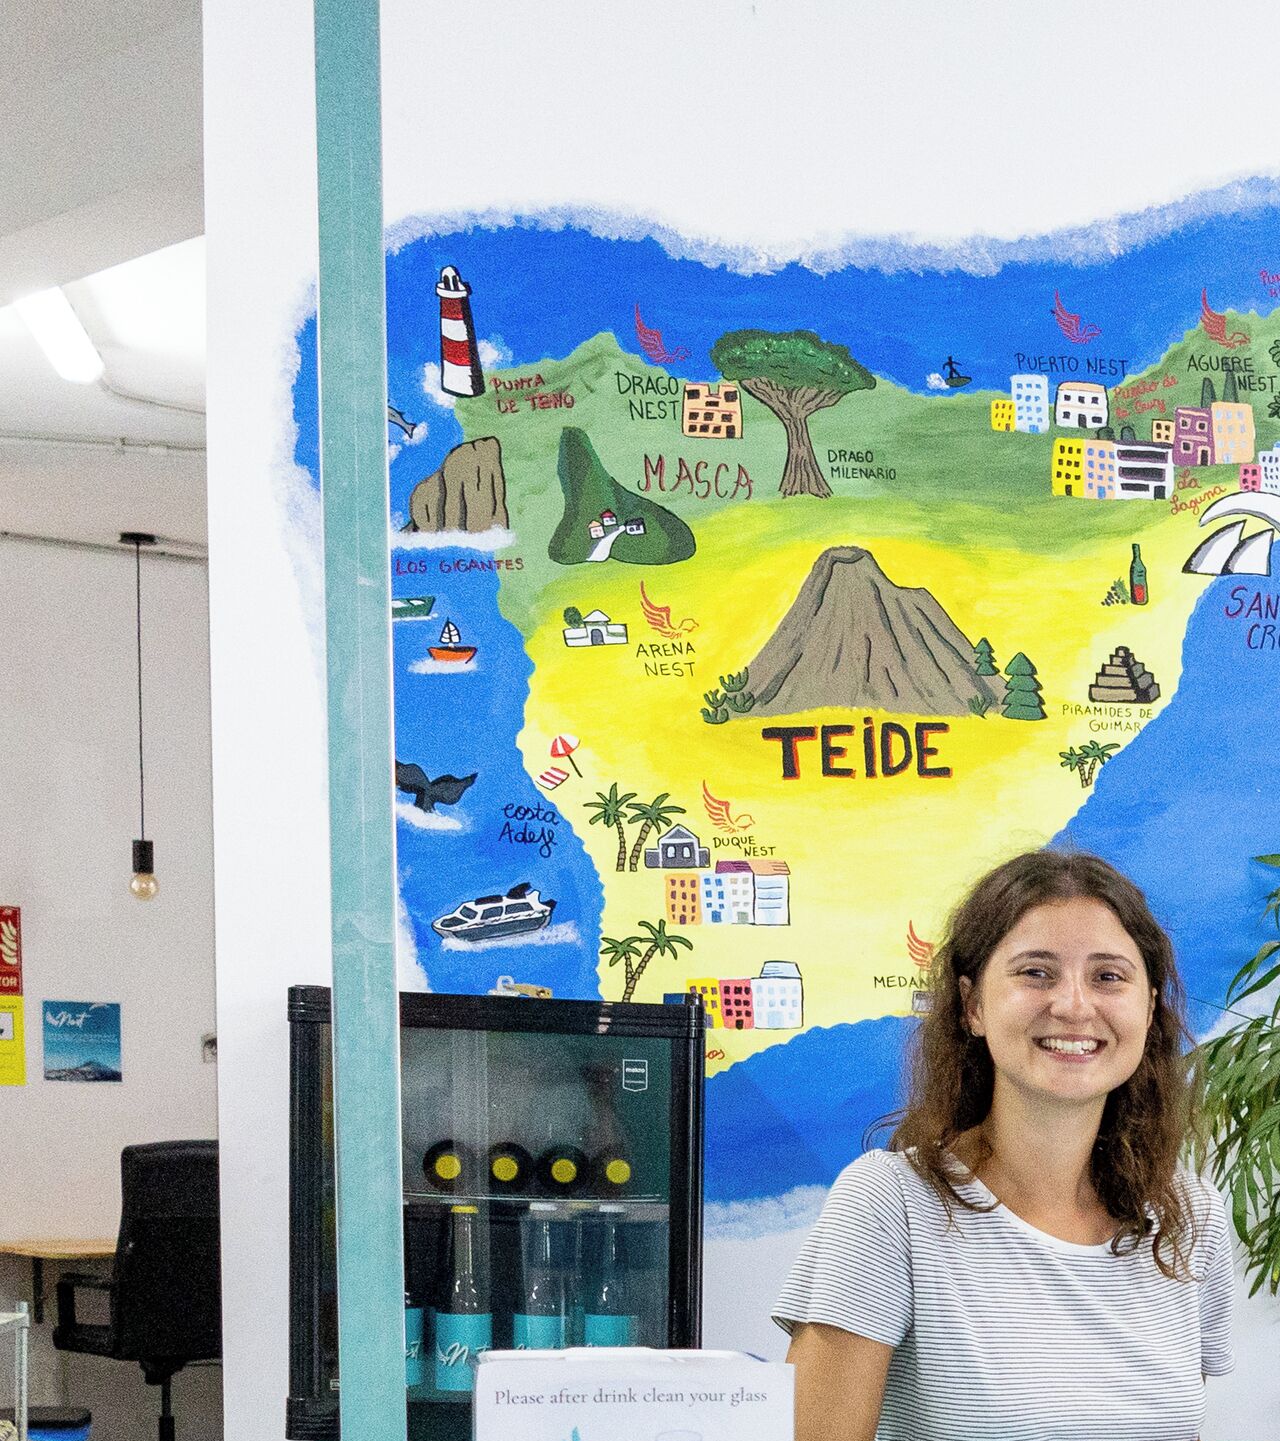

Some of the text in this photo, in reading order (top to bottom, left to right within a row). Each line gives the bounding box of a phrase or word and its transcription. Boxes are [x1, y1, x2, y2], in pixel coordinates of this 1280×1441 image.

[1014, 352, 1129, 378] PUERTO NEST
[1187, 354, 1255, 373] AGUERE
[489, 374, 545, 393] PUNTA
[616, 371, 680, 397] DRAGO
[1236, 375, 1278, 393] NEST
[496, 392, 576, 414] DE TENO
[630, 400, 679, 421] NEST
[827, 449, 874, 465] DRAGO
[638, 453, 756, 501] MASCA
[830, 464, 897, 481] MILENARIO
[1177, 468, 1202, 490] La
[1170, 485, 1227, 516] Laguna
[396, 557, 525, 575] LOS GIGANTES
[636, 641, 697, 657] ARENA
[644, 661, 696, 677] NEST
[1139, 708, 1153, 719] DE
[499, 821, 557, 857] Adeje
[713, 835, 756, 849] DUQUE
[744, 846, 776, 857] NEST
[495, 1386, 768, 1407] Please after drink clean your glass
